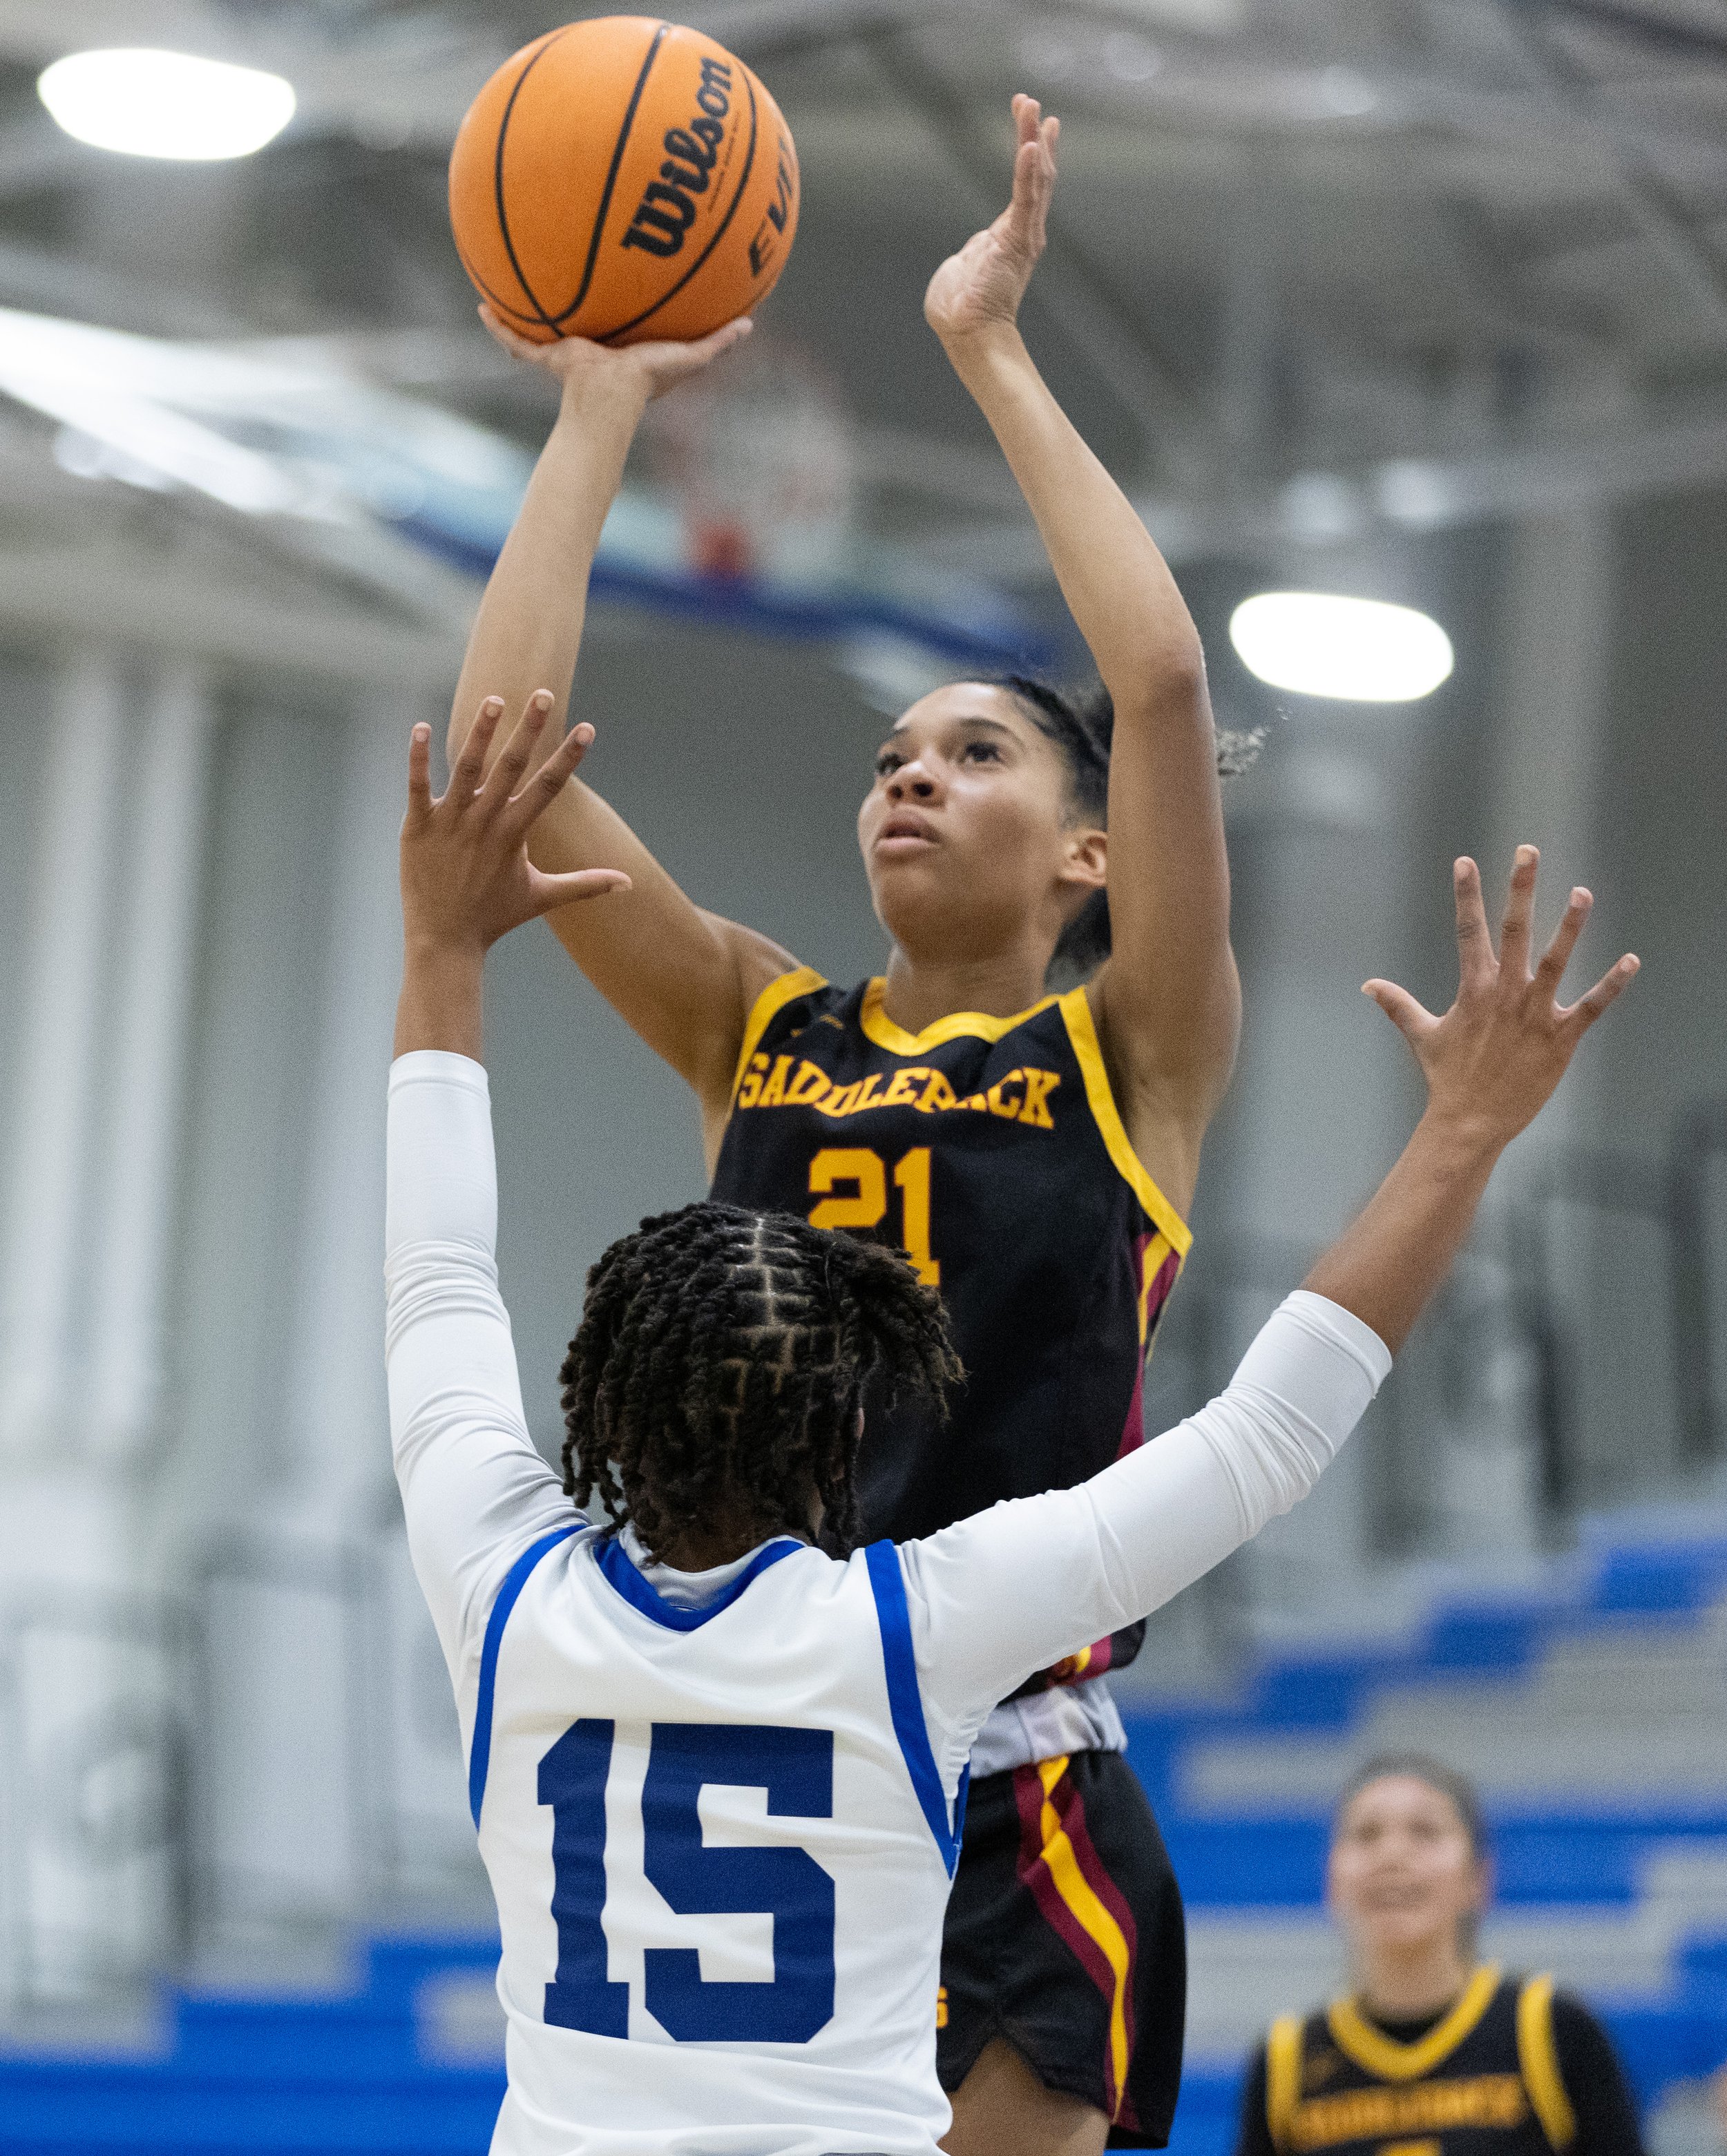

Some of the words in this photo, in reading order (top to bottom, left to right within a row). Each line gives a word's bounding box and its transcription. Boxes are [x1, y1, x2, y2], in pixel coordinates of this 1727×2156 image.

[622, 57, 732, 257] Wilson
[808, 1147, 940, 1286] 21
[537, 1717, 835, 2043] 15
